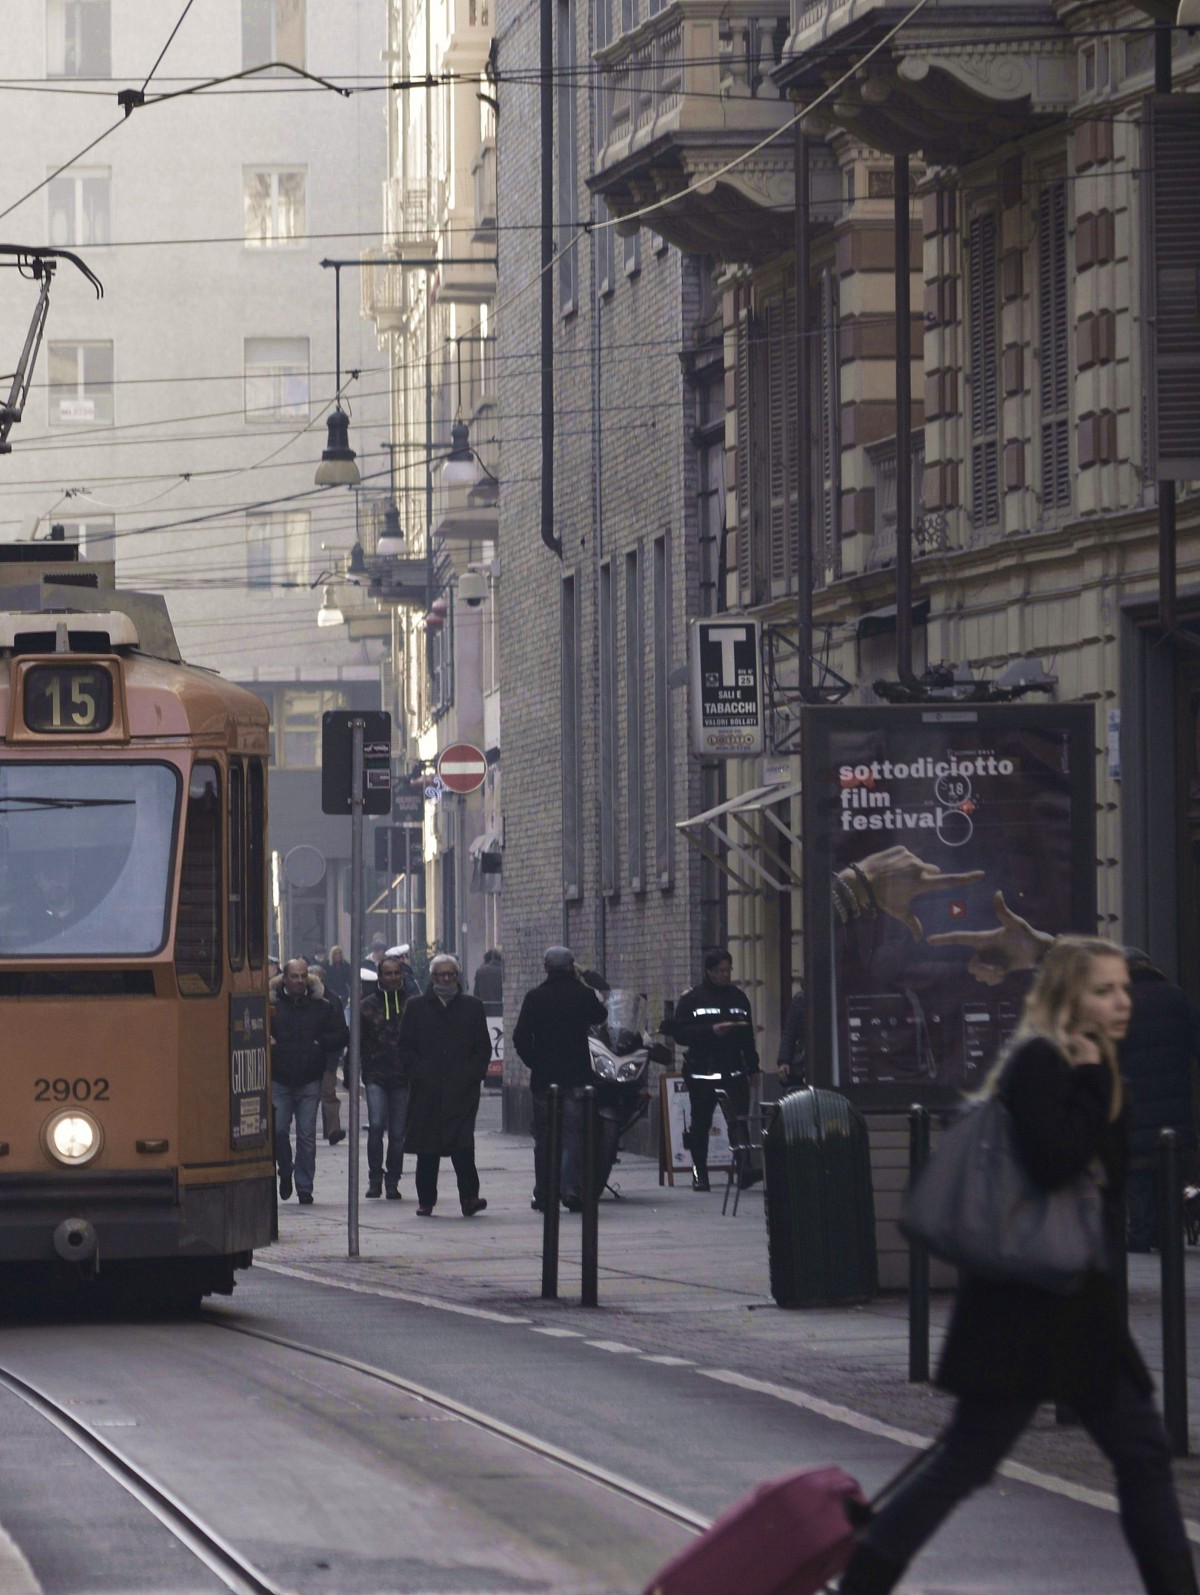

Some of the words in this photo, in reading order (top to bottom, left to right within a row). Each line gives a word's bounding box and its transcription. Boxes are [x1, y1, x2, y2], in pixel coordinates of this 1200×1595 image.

[708, 628, 747, 687] T
[740, 677, 751, 686] 25
[45, 675, 96, 726] 15
[718, 690, 735, 699] SALI
[736, 690, 742, 699] E
[704, 702, 756, 714] TABACCHI
[704, 718, 728, 726] VALORI
[730, 717, 757, 726] BOLLATI
[839, 756, 1014, 780] sottodiciotto
[840, 788, 891, 809] film
[948, 782, 964, 796] 18
[840, 807, 944, 831] festival
[232, 1047, 266, 1095] GIUBILEO
[34, 1077, 110, 1102] 2902
